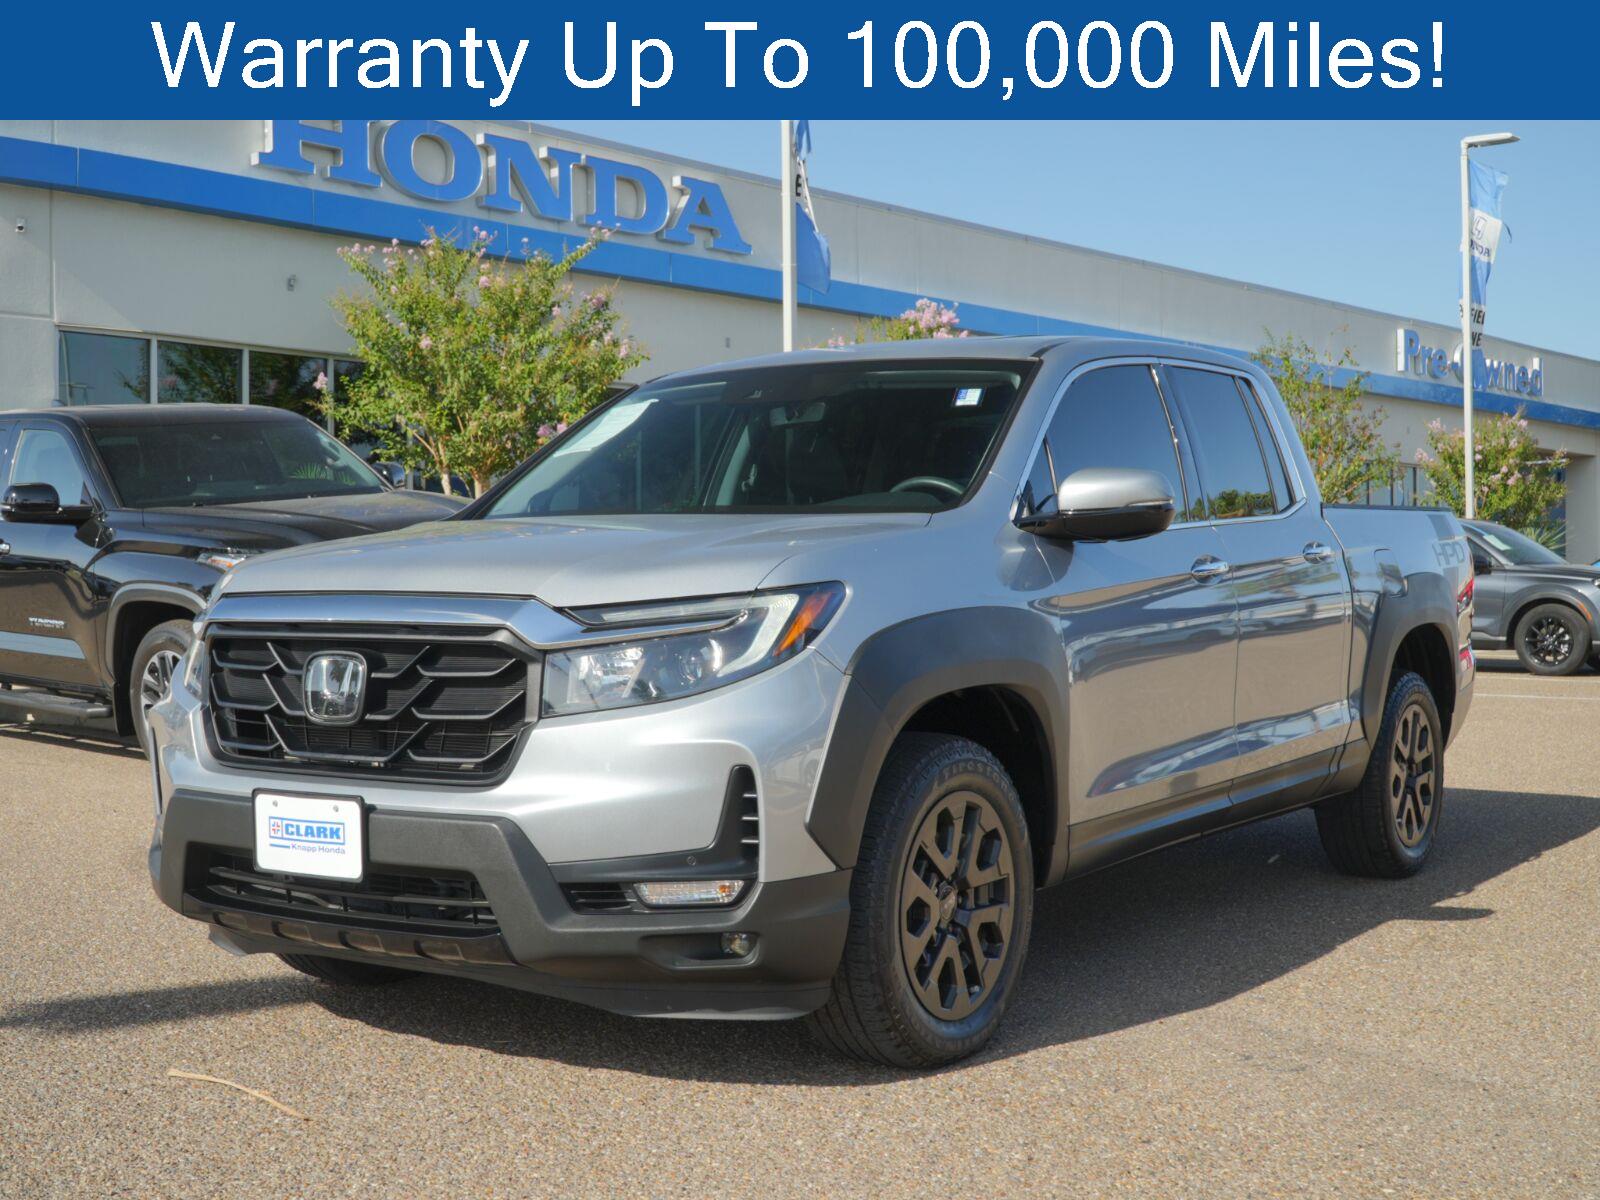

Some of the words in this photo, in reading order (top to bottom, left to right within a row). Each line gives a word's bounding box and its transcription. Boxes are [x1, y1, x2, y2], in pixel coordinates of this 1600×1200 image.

[250, 120, 752, 255] HONDA
[1432, 541, 1466, 567] HPD
[284, 823, 342, 840] CLARK
[291, 843, 318, 854] Knapp
[318, 845, 346, 855] Honda
